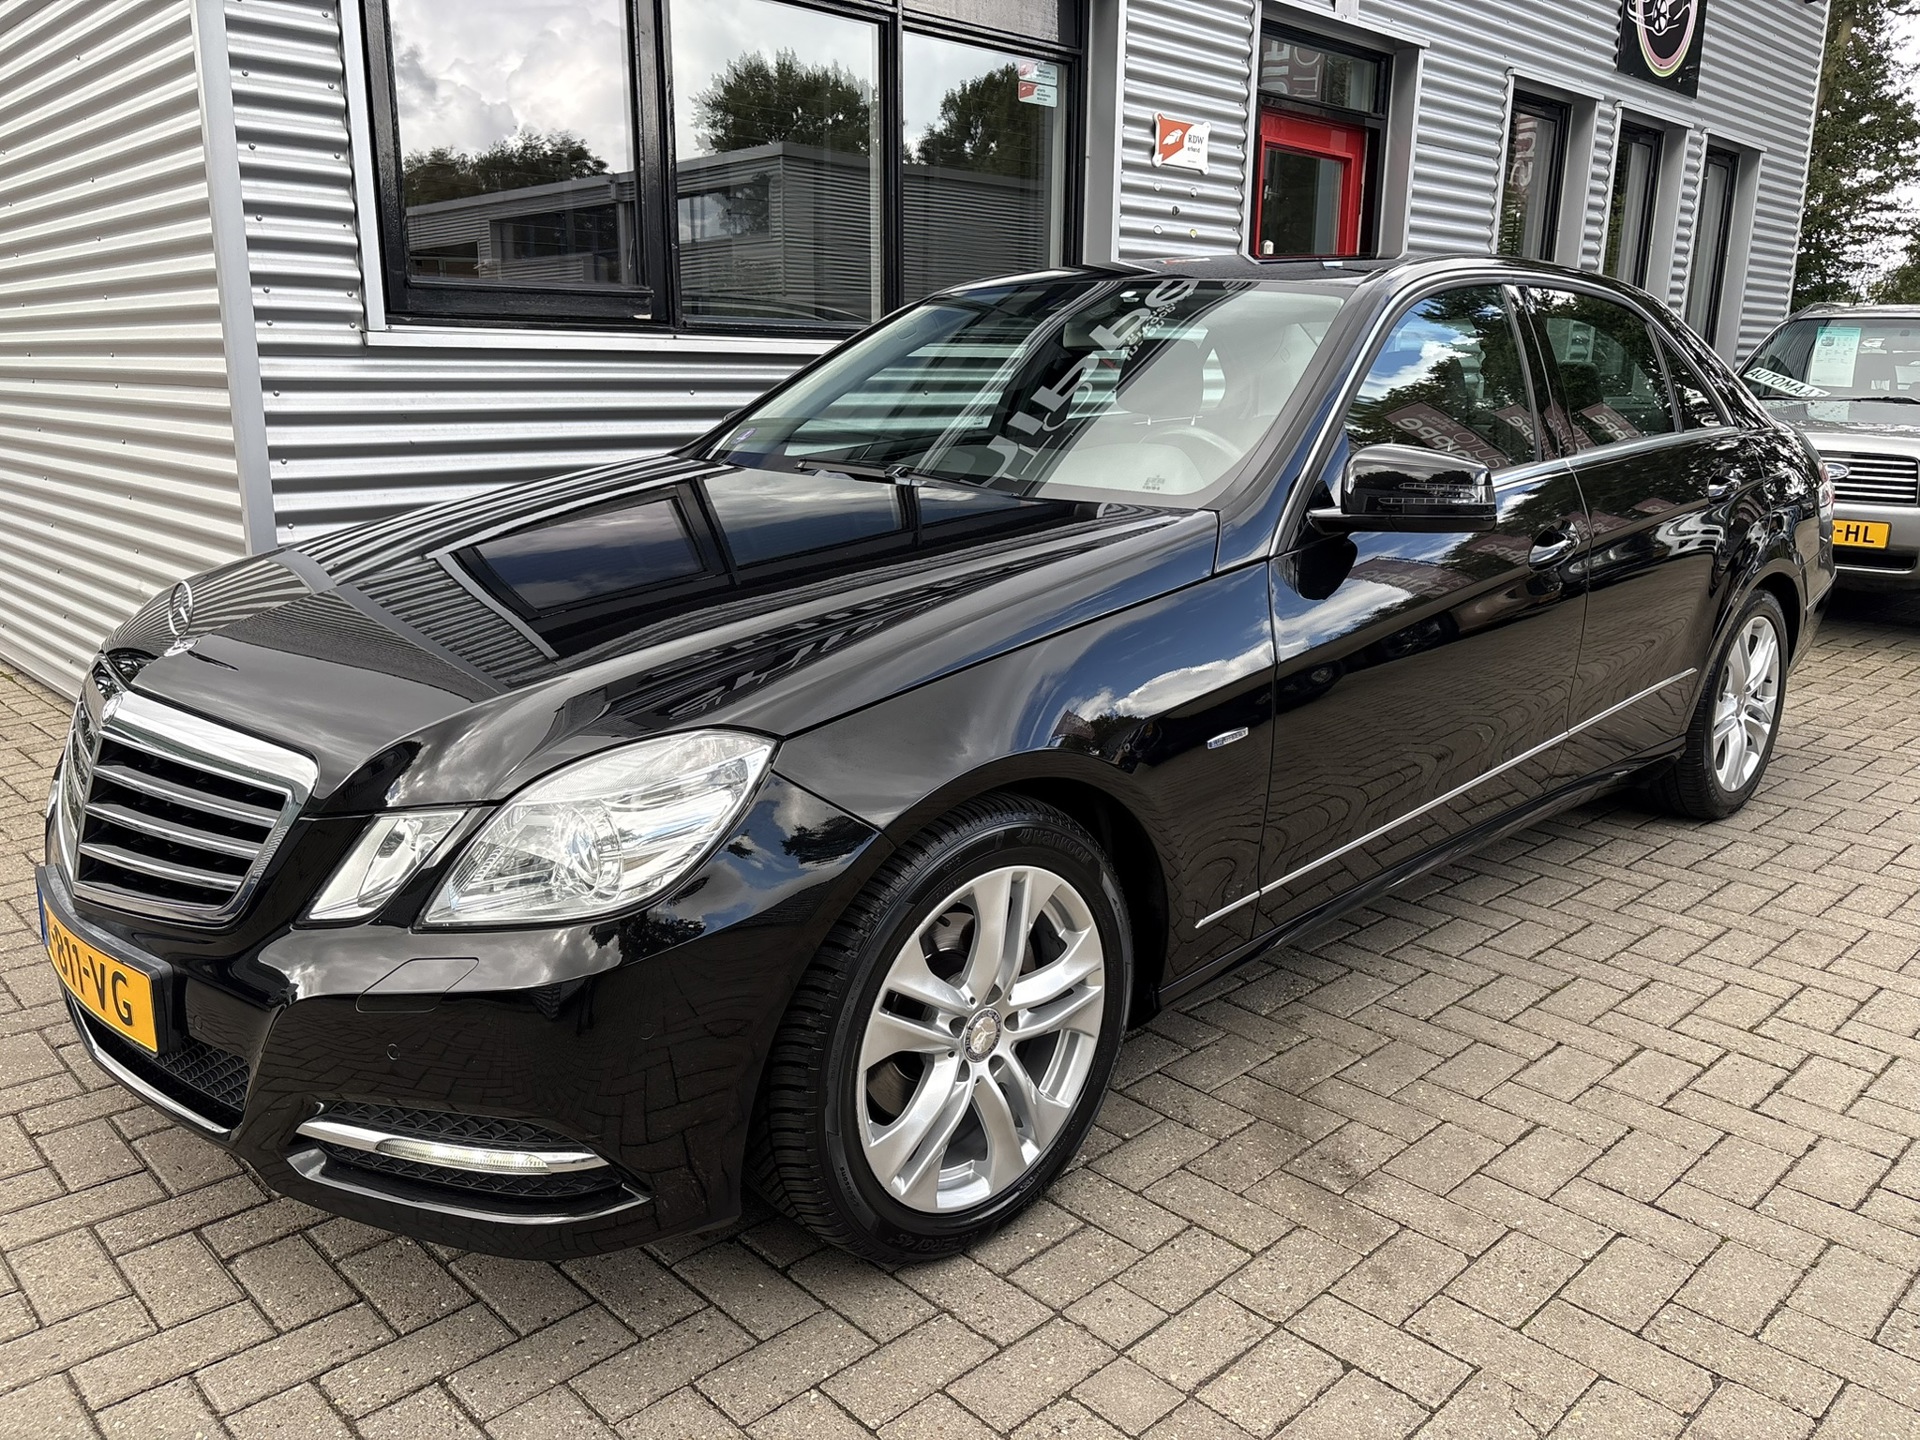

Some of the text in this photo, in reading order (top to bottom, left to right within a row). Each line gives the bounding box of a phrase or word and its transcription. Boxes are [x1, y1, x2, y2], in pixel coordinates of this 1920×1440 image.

[1188, 134, 1204, 145] RDW
[1746, 367, 1828, 397] AUTOMAAT
[1833, 524, 1875, 544] -HL
[51, 924, 133, 1027] -811-VG
